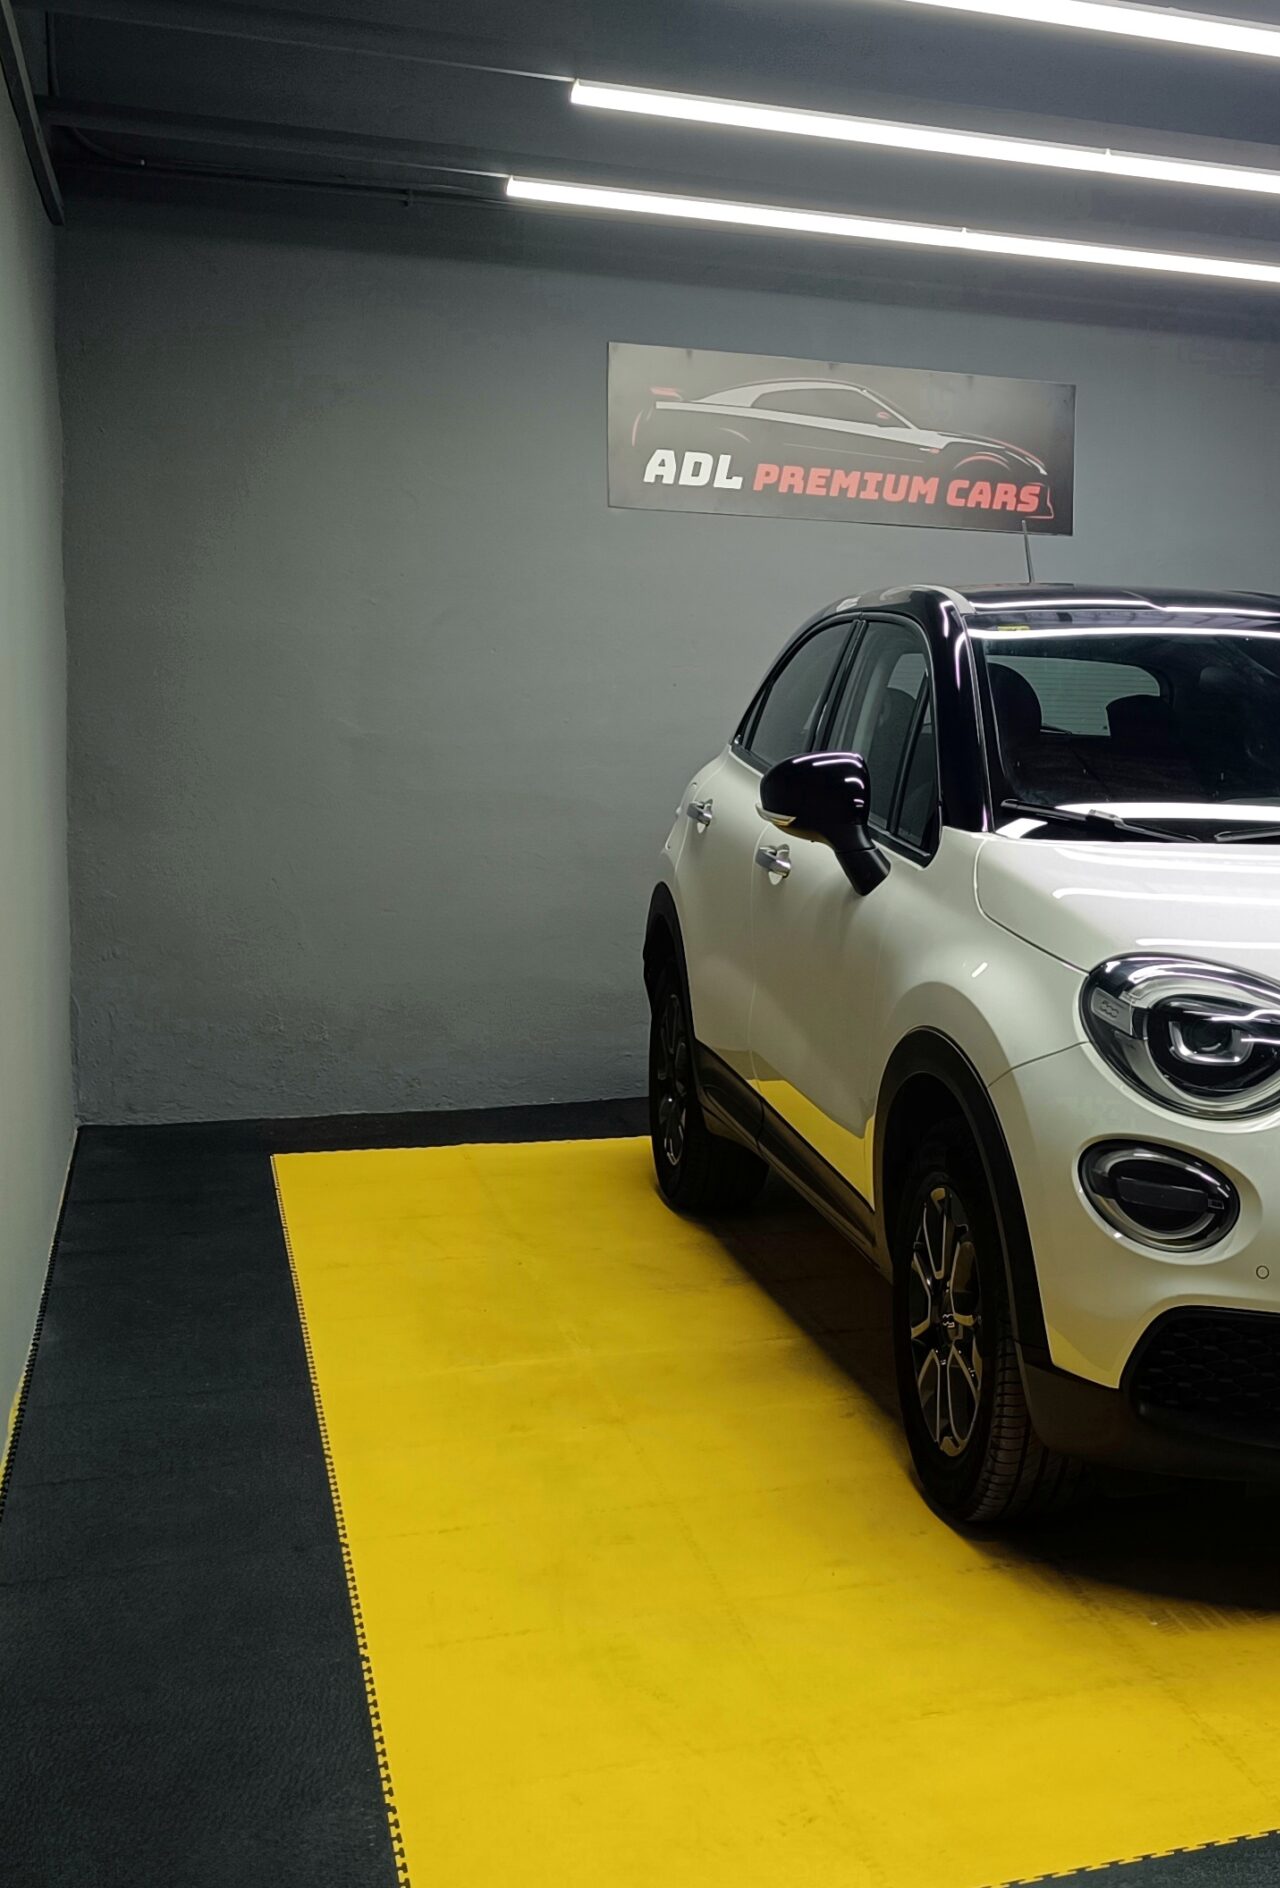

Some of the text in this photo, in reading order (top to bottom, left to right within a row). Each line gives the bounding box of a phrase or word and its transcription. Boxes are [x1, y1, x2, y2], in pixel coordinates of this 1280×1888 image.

[643, 448, 1041, 512] ADL PREMIUM CARS
